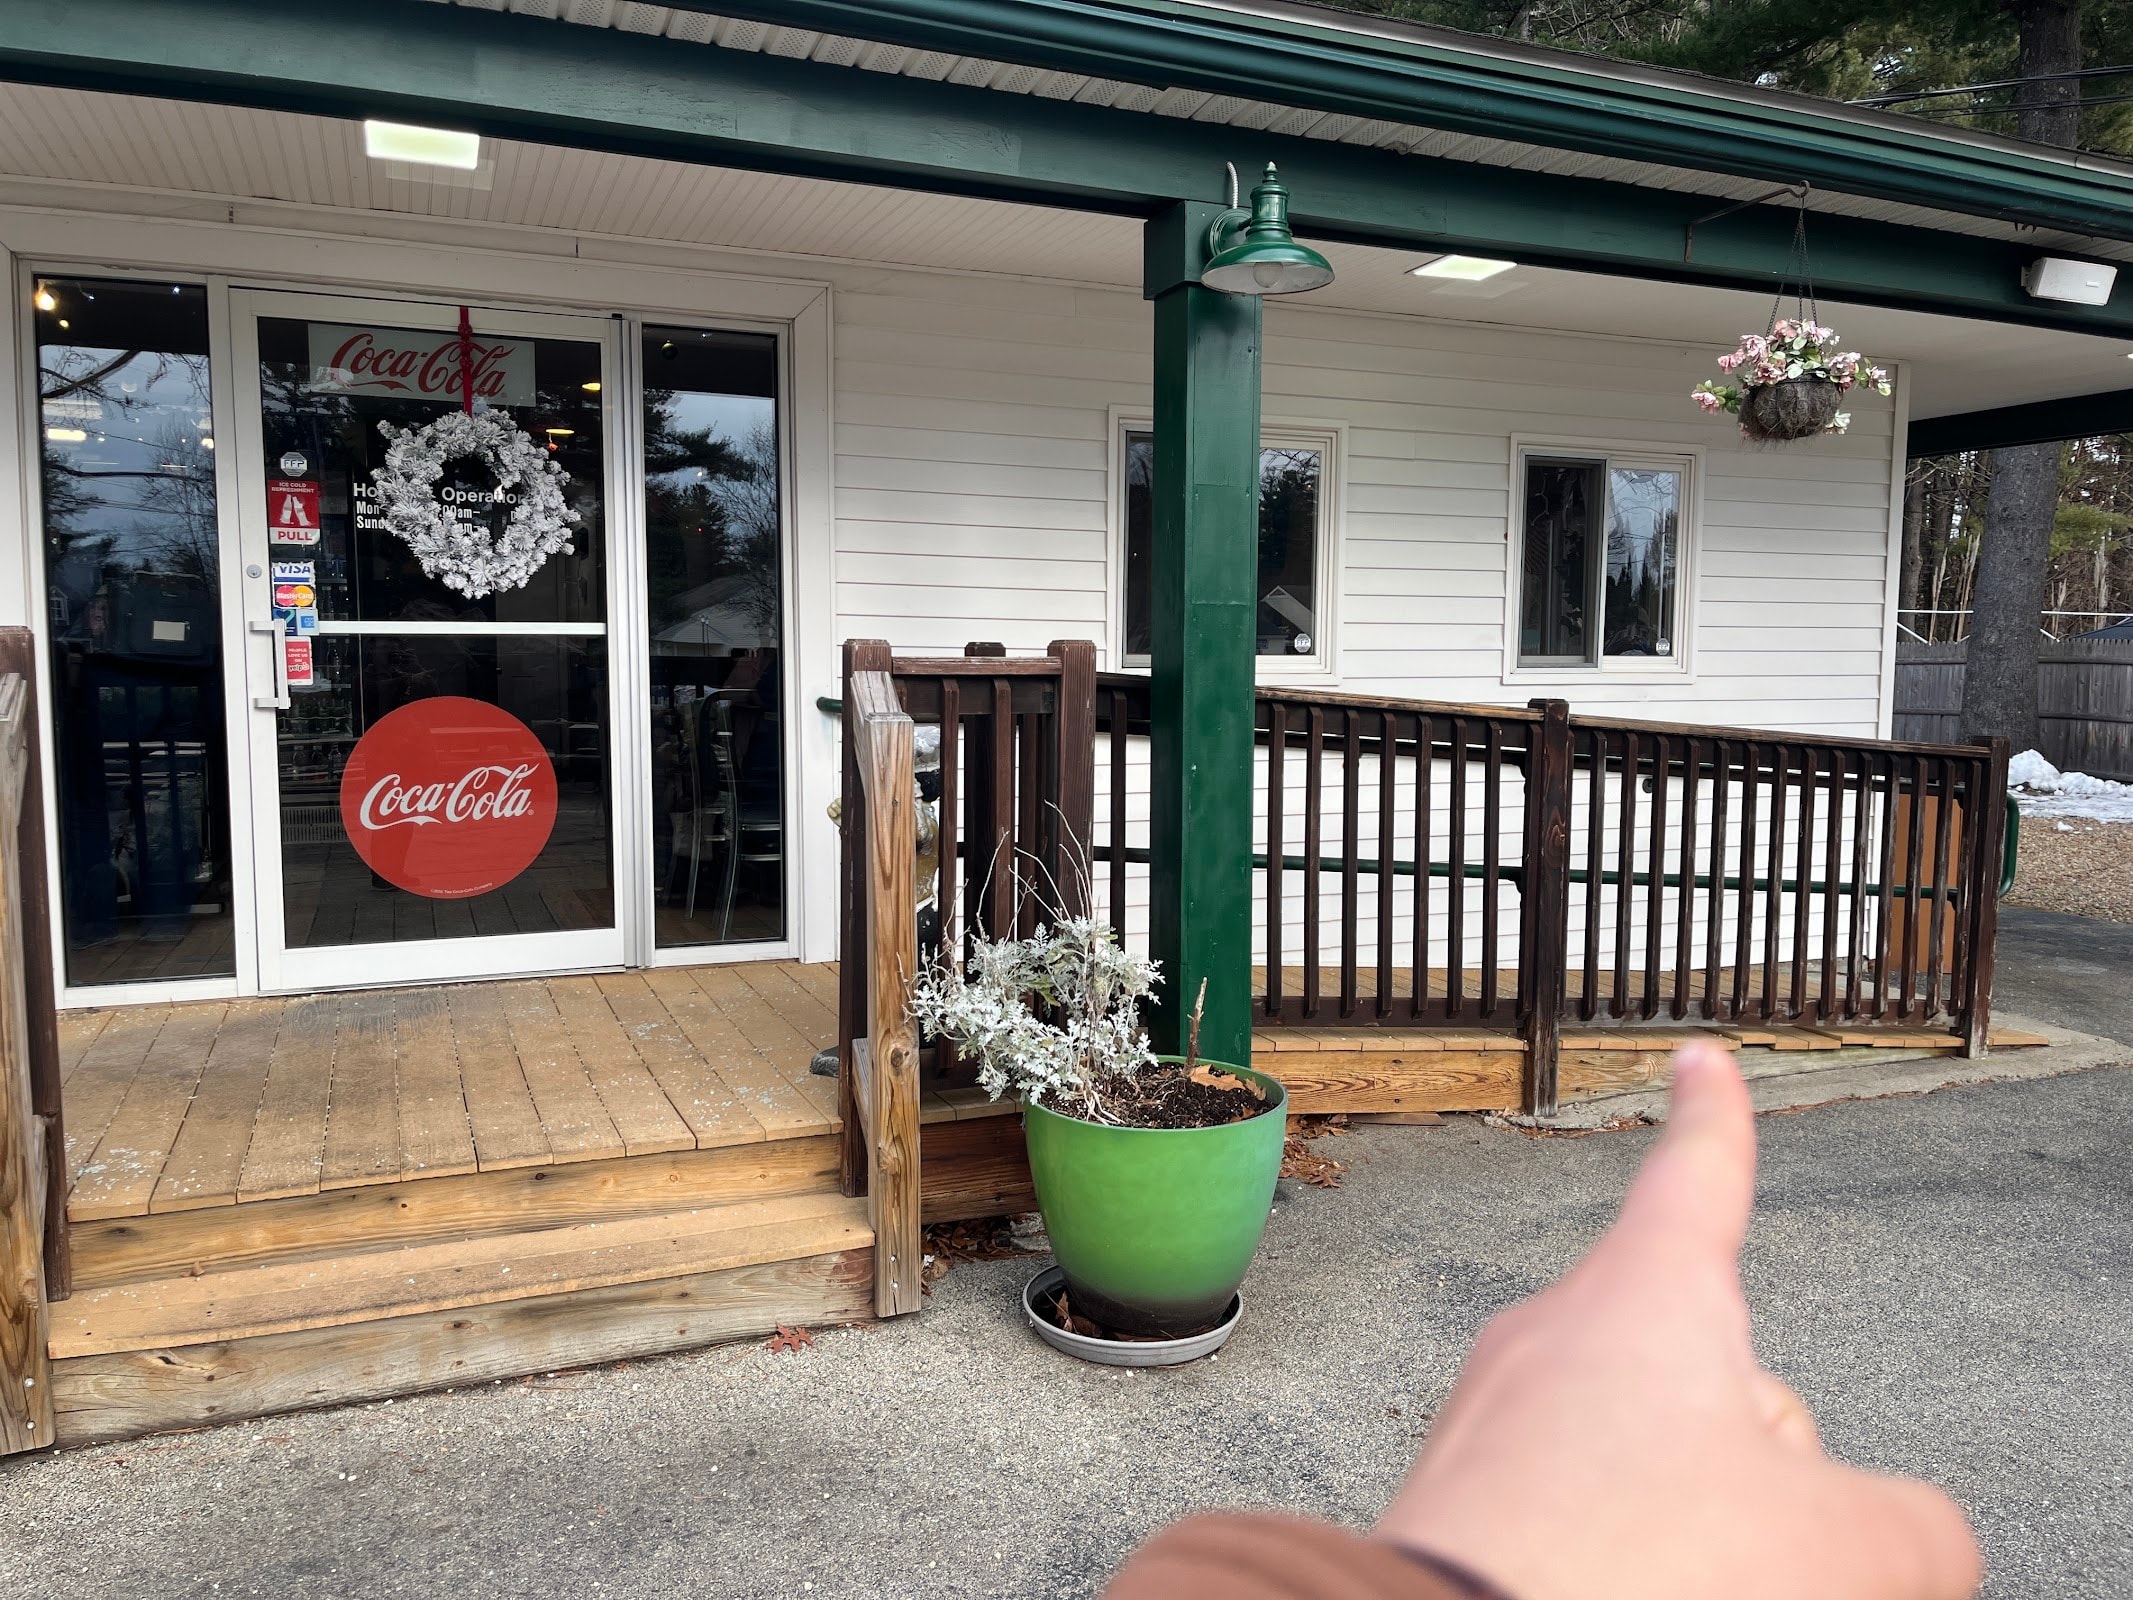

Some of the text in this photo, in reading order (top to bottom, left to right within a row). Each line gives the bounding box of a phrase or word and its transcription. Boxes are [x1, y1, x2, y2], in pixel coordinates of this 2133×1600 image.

[331, 333, 516, 398] Coca-Cola
[353, 483, 378, 498] Ho
[357, 501, 380, 515] Mon
[357, 515, 385, 530] Sund
[278, 531, 312, 541] PULL
[280, 565, 311, 574] VISA
[360, 762, 540, 831] Coca-Cola
